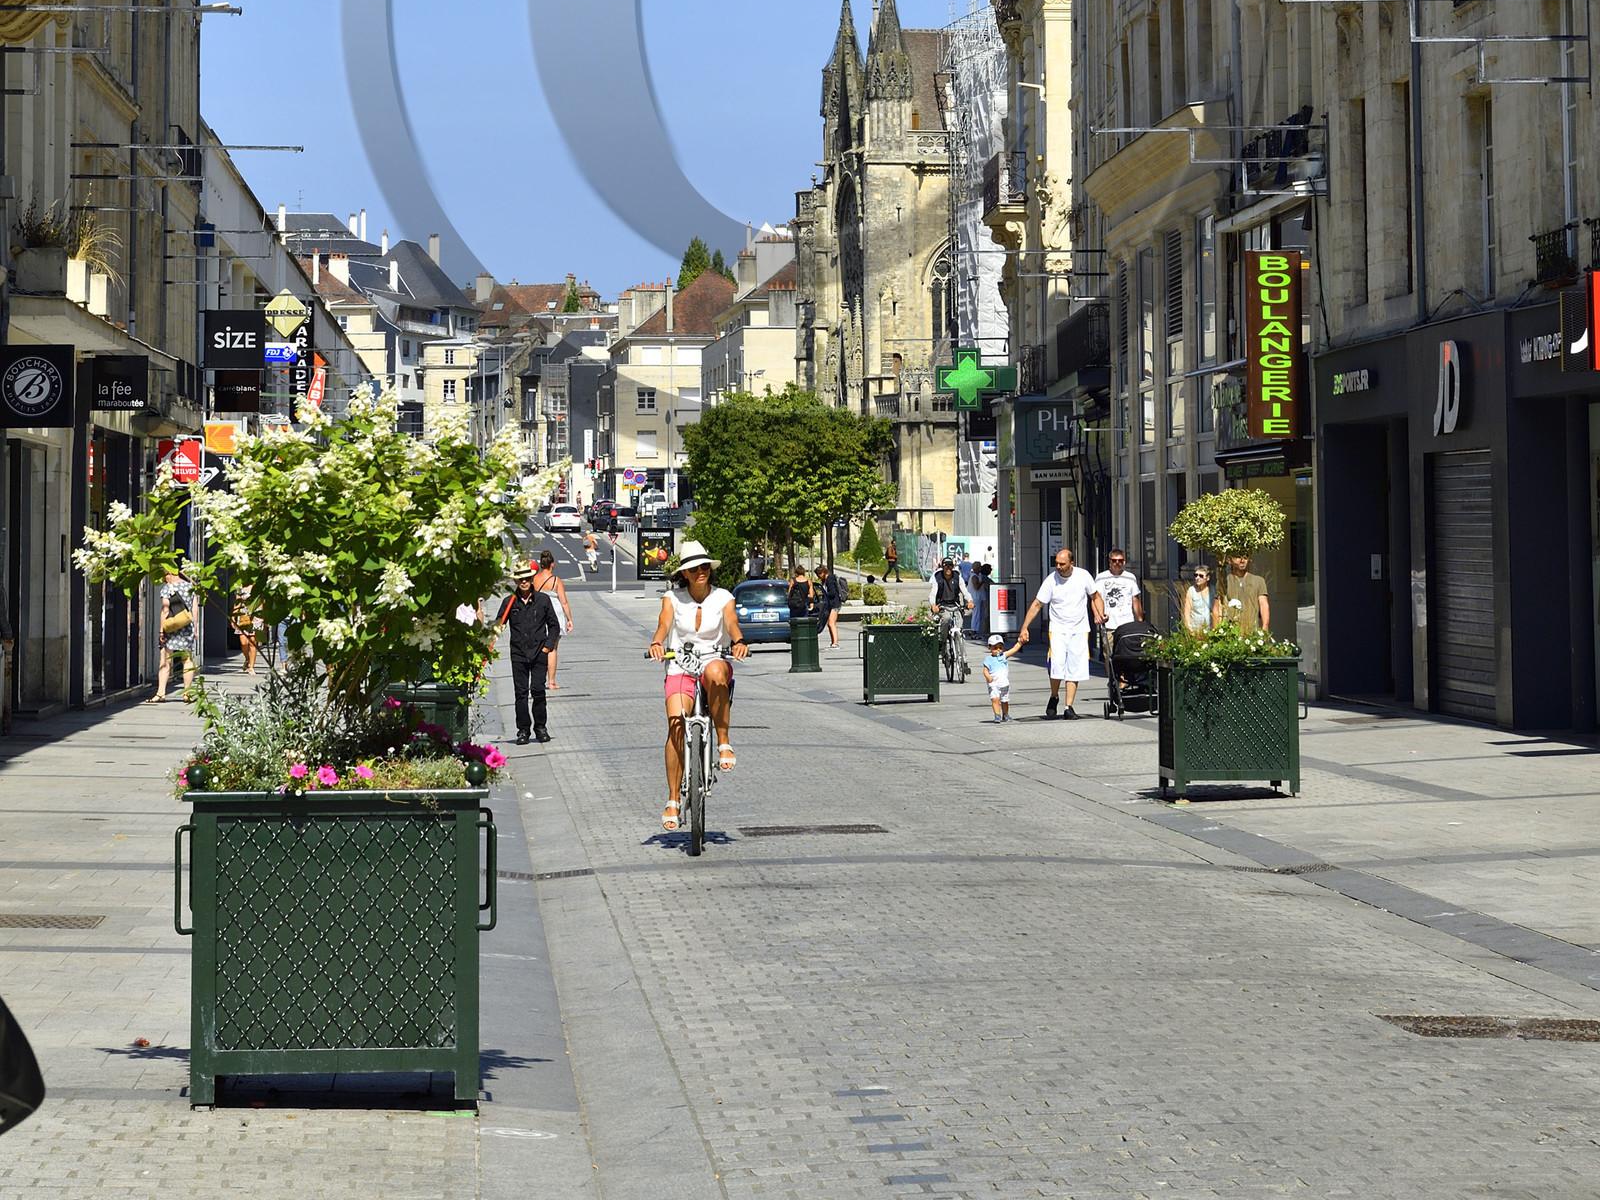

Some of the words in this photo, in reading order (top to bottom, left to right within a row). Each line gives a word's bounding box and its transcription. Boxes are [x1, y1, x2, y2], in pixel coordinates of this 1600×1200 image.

[1257, 255, 1293, 435] BOULANGERIE
[6, 359, 58, 383] BOUCHARA
[98, 383, 109, 395] la
[111, 380, 132, 400] fée
[1433, 339, 1461, 438] JD
[7, 392, 36, 412] DEPUIS
[98, 398, 145, 408] maraboutée
